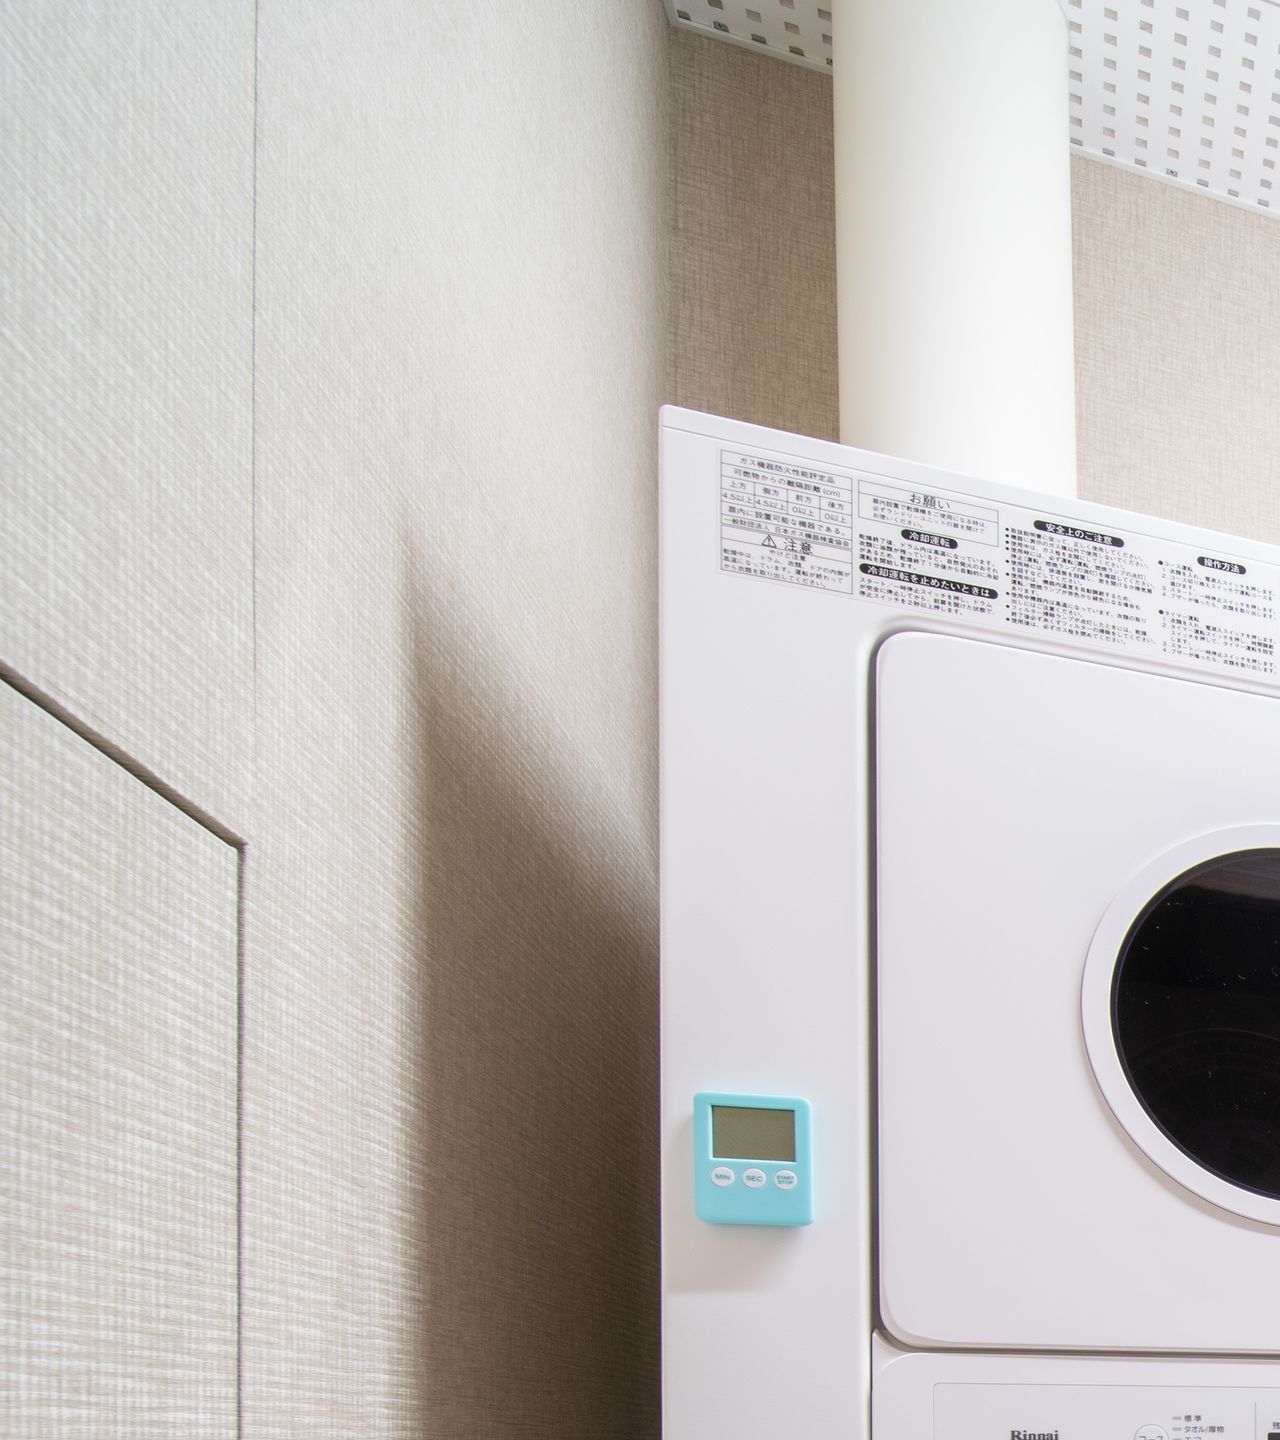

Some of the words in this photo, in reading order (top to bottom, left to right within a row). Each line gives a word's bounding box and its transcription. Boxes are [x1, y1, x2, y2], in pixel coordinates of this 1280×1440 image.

[910, 491, 950, 511] お願い
[908, 531, 950, 547] 冷却運転
[1045, 522, 1112, 545] 安全上のご注意
[784, 537, 813, 555] 注意
[1203, 557, 1239, 573] 操作方法
[867, 565, 989, 597] 冷却運転を止めたいときは
[1011, 1430, 1059, 1440] Rinnai
